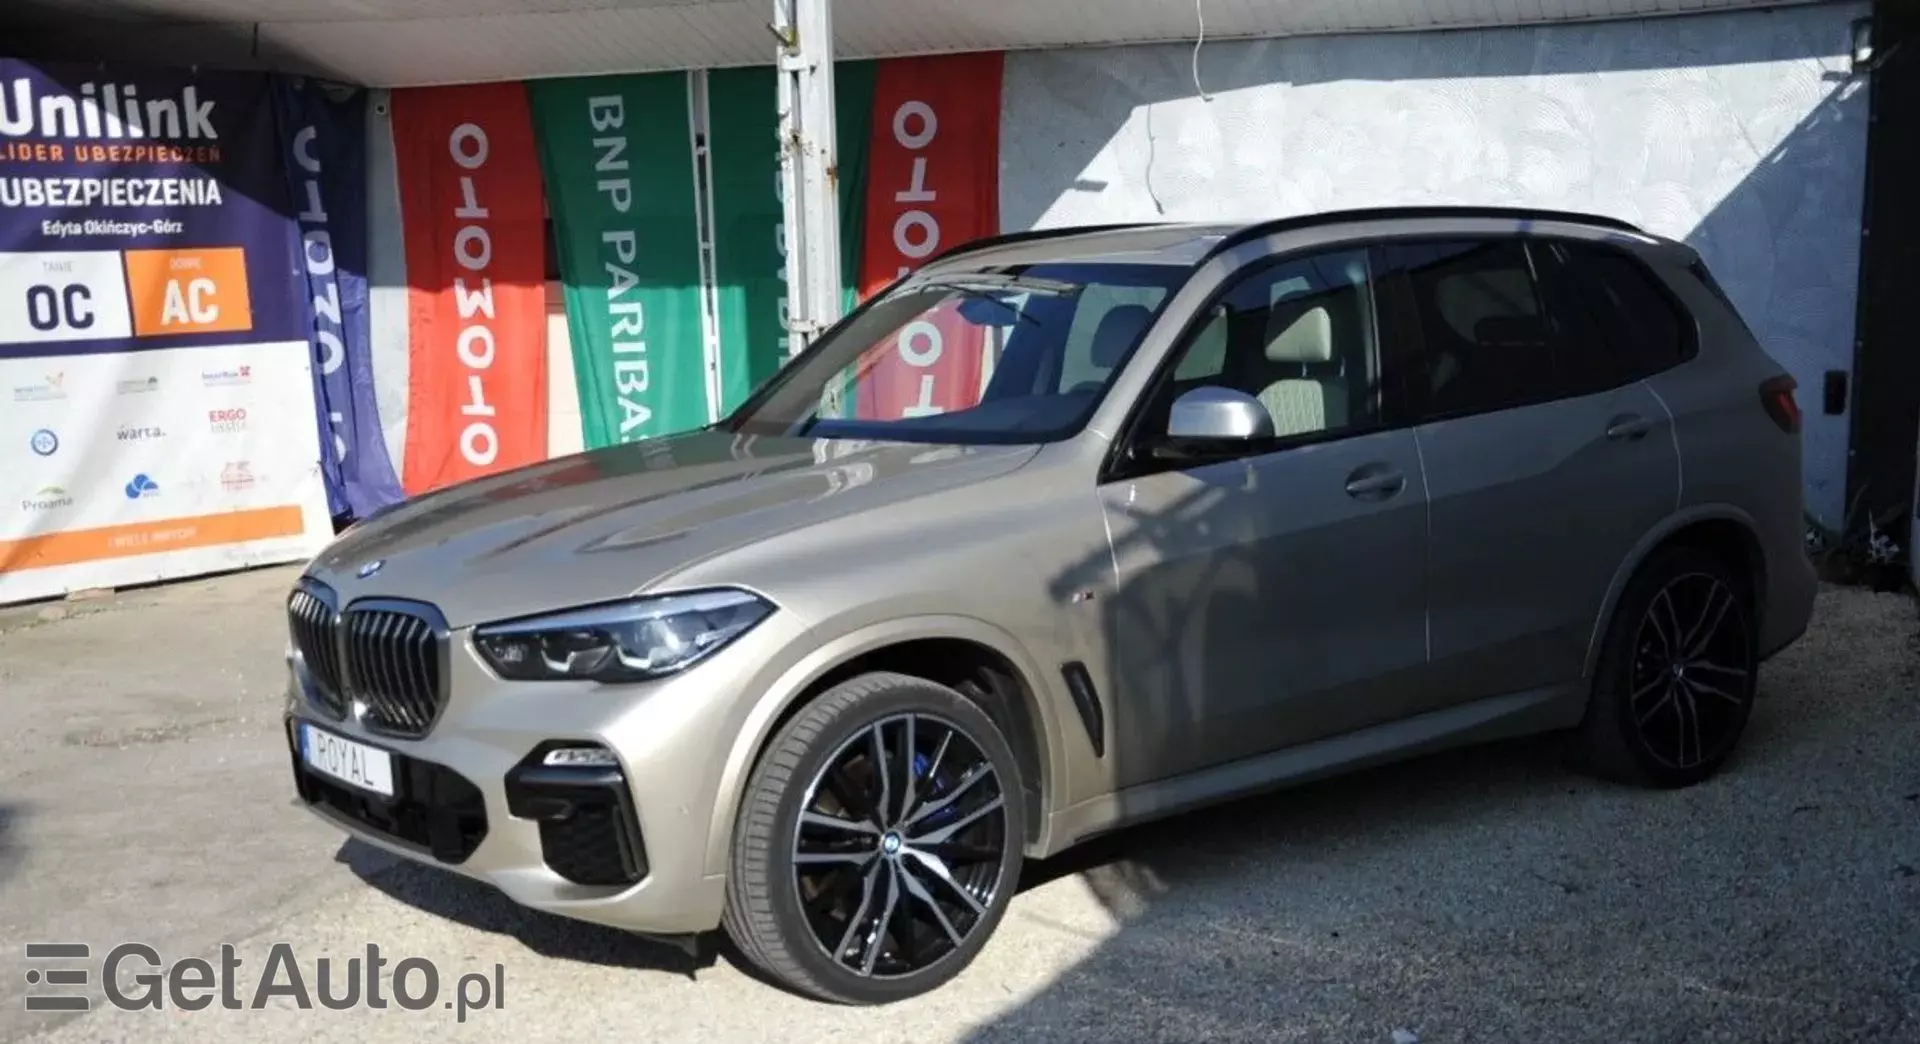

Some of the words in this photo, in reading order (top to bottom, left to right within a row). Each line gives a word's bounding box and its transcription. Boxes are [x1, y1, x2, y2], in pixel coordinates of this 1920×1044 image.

[0, 78, 218, 138] Unilink
[588, 95, 633, 213] BNP
[0, 177, 223, 207] UBEZPIECZENIA
[42, 220, 83, 238] Edyta
[26, 284, 95, 331] OC
[161, 277, 220, 326] AC
[449, 123, 499, 466] OTOMOTO
[602, 230, 652, 443] PARIBA
[208, 408, 247, 422] ERGO
